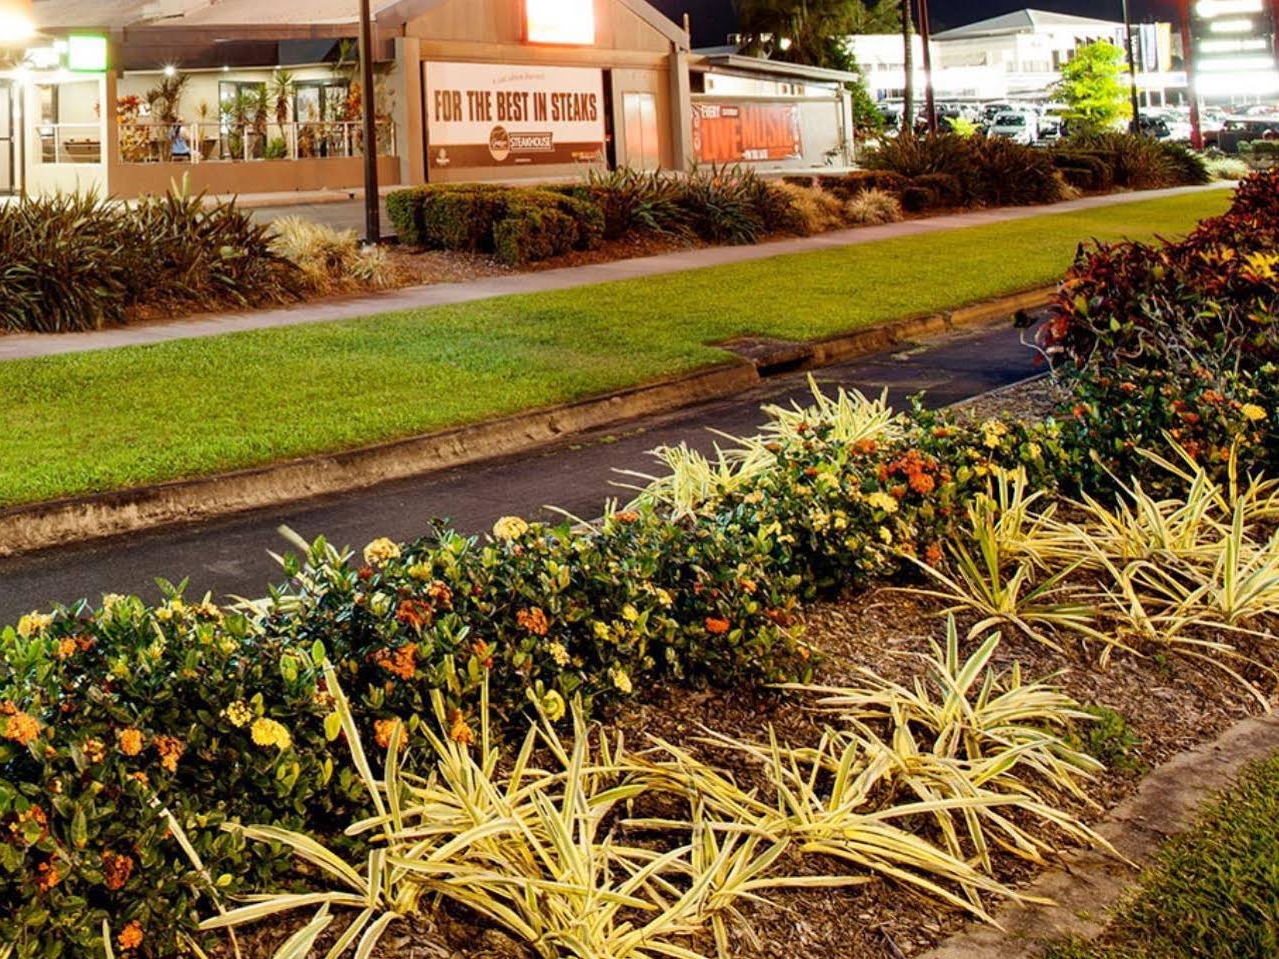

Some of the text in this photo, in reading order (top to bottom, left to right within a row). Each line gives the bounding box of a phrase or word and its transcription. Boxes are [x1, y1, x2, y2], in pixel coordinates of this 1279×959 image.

[435, 90, 598, 123] FOR THE BEST IN STEAKS
